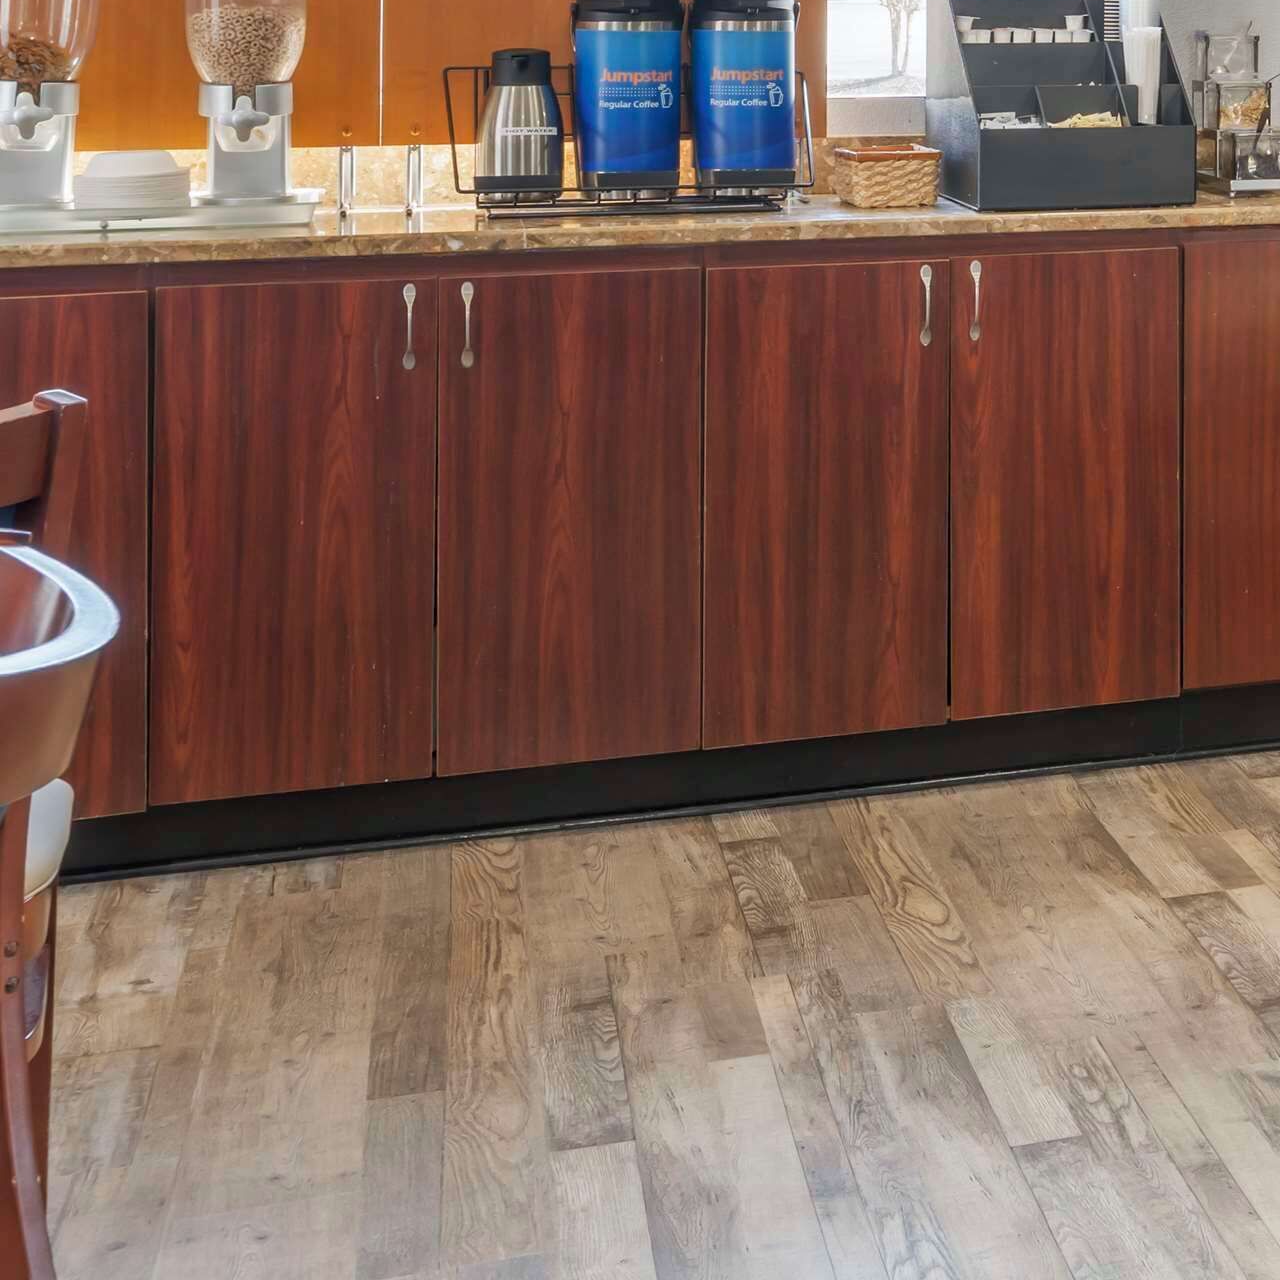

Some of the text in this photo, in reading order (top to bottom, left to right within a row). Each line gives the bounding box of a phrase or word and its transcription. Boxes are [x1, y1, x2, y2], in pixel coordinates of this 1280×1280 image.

[600, 67, 673, 86] Jumpstart
[710, 65, 785, 84] Jumpstart
[599, 99, 660, 109] Regular Coffee
[709, 97, 768, 108] Regular Coffee
